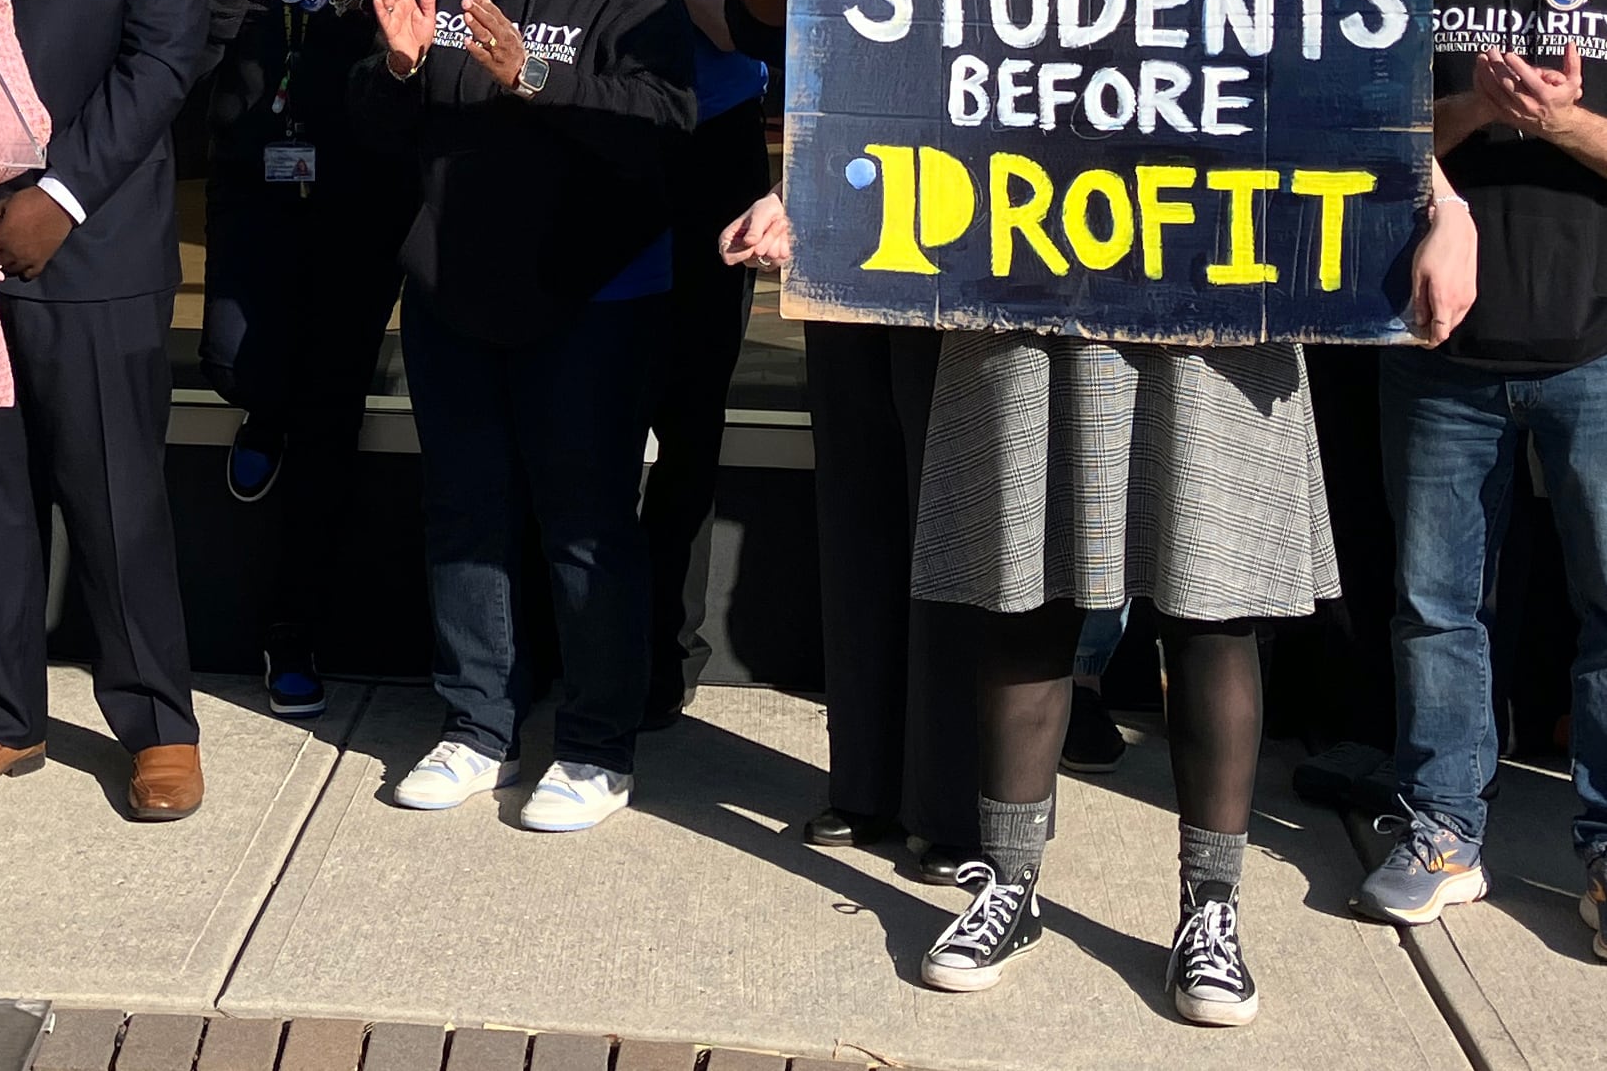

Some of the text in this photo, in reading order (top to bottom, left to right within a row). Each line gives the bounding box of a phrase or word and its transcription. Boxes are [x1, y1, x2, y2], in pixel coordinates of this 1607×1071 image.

[1431, 7, 1607, 36] SOLIDARIT
[524, 41, 577, 57] DERATION
[1434, 31, 1471, 43] CULTY
[1473, 31, 1501, 43] AND
[948, 54, 1253, 135] BEFORE
[858, 143, 1378, 292] PROFIT
